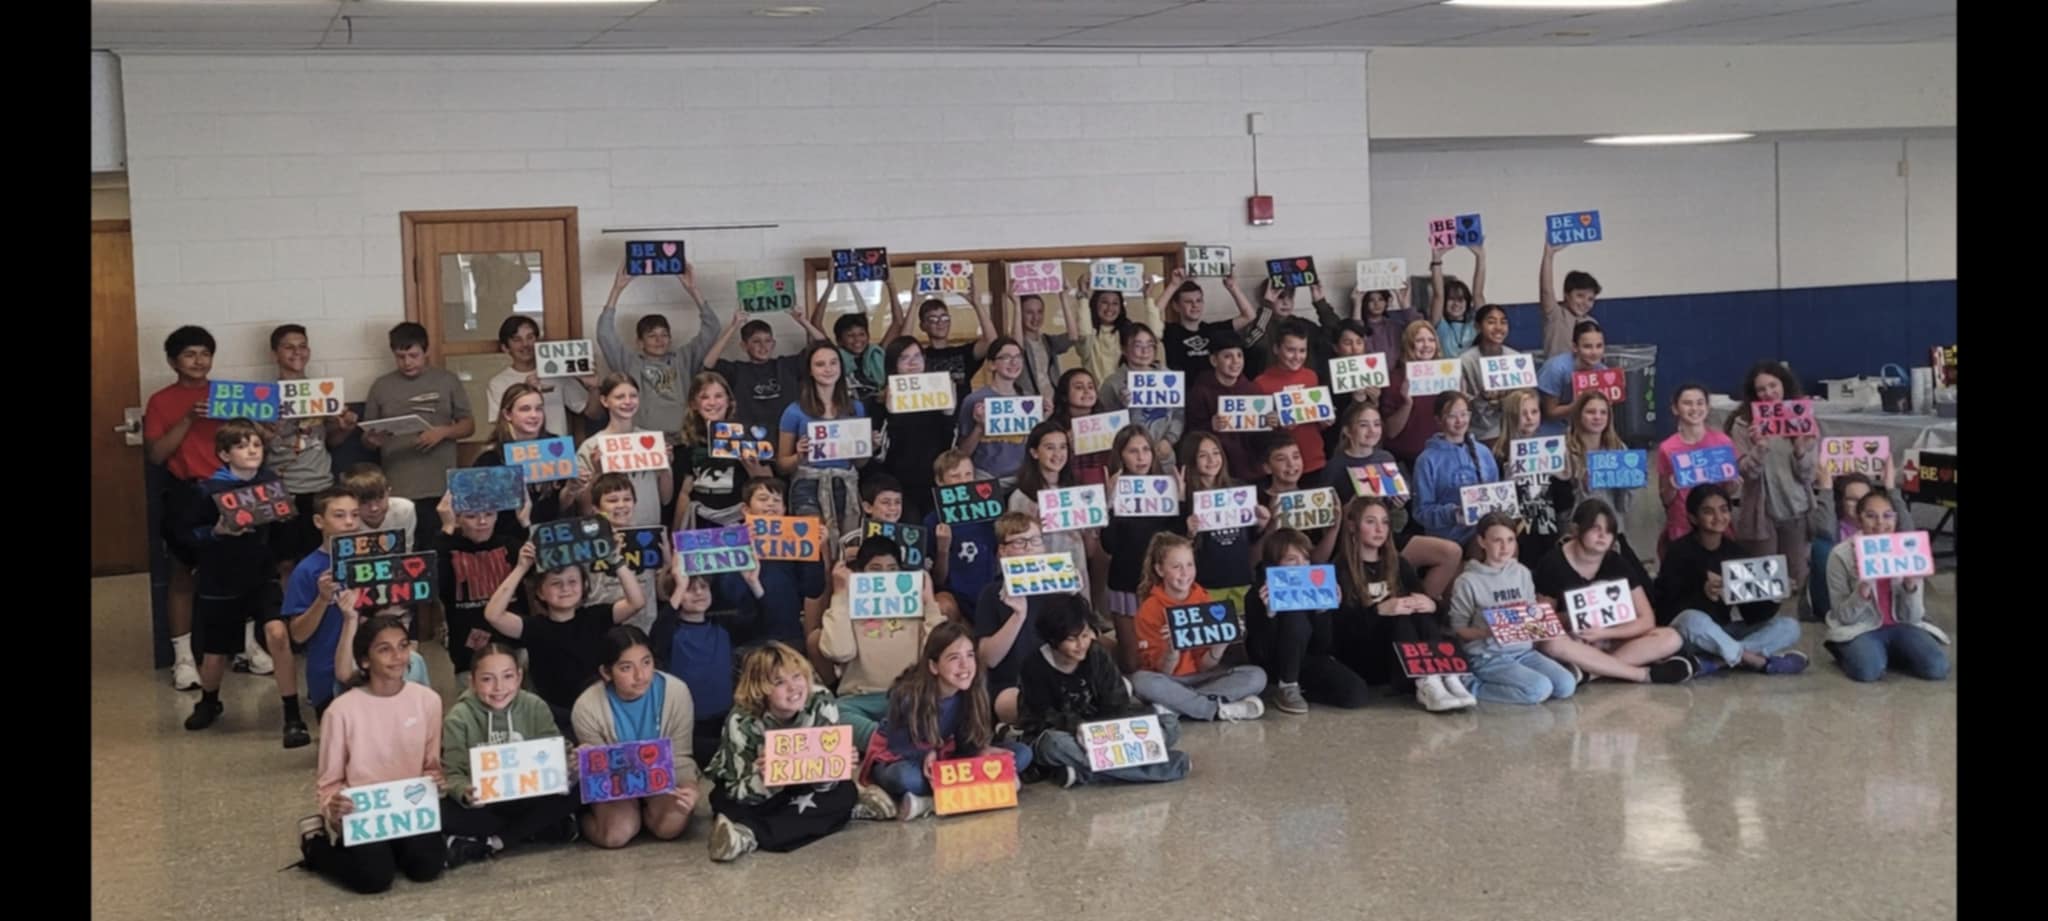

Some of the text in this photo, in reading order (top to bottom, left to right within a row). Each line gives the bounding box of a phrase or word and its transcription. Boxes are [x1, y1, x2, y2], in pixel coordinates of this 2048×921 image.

[1434, 219, 1456, 232] BE
[1552, 216, 1574, 229] BE
[1433, 229, 1479, 246] KIND
[1551, 228, 1597, 244] KIND
[632, 243, 656, 257] BE
[1190, 248, 1209, 260] BE
[632, 259, 682, 274] KIND
[836, 265, 884, 281] KIND
[921, 263, 944, 275] BE
[1014, 264, 1038, 278] BE
[1096, 264, 1117, 275] BE
[920, 277, 970, 291] KIND
[1094, 276, 1140, 289] KIND
[1271, 271, 1314, 288] KIND
[744, 294, 792, 312] KIND
[538, 342, 589, 358] KIND
[565, 359, 589, 371] BE
[1336, 360, 1359, 374] BE
[1412, 363, 1434, 376] BE
[1488, 359, 1508, 371] BE
[895, 377, 921, 392] BE
[1134, 374, 1157, 388] BE
[1337, 372, 1385, 389] KIND
[1411, 379, 1457, 392] KIND
[1489, 372, 1533, 388] KIND
[1578, 373, 1599, 388] BE
[216, 384, 245, 399] BE
[284, 383, 311, 398] BE
[1133, 391, 1181, 405] KIND
[281, 400, 339, 415] KIND
[895, 391, 950, 410] KIND
[990, 401, 1013, 414] BE
[1224, 399, 1245, 412] BE
[1280, 393, 1304, 407] BE
[212, 401, 274, 418] KIND
[1280, 404, 1330, 425] KIND
[1760, 403, 1784, 417] BE
[714, 422, 744, 438] BE
[815, 424, 839, 439] BE
[990, 417, 1039, 432] KIND
[1077, 420, 1100, 434] BE
[1761, 419, 1811, 435] KIND
[606, 438, 632, 451] BE
[711, 440, 775, 459] KIND
[1078, 435, 1114, 452] KIN
[1517, 442, 1539, 456] BE
[1827, 442, 1853, 455] BE
[513, 445, 541, 462] BE
[607, 452, 664, 470] KIND
[1591, 454, 1617, 469] BE
[531, 460, 574, 481] IND
[1513, 455, 1562, 472] KIND
[1827, 458, 1884, 472] KIND
[1591, 470, 1644, 488] KIND
[1678, 463, 1735, 485] KIND
[1920, 466, 1938, 480] BE
[221, 483, 288, 509] KIND
[941, 485, 969, 504] BE
[1120, 480, 1145, 495] BE
[1045, 491, 1072, 507] BE
[1120, 498, 1174, 513] KIND
[1200, 492, 1225, 509] BE
[1280, 495, 1305, 510] BE
[262, 500, 290, 518] BE
[943, 501, 1002, 523] KIND
[1043, 507, 1103, 530] KIND
[1200, 510, 1252, 528] KIND
[1281, 508, 1330, 528] KIND
[540, 523, 574, 543] BE
[754, 520, 782, 535] BE
[337, 536, 370, 554] BE
[681, 532, 710, 548] BE
[755, 540, 813, 557] KIND
[1863, 538, 1892, 555] BE
[539, 538, 610, 571] KIND
[684, 551, 749, 572] KIND
[354, 559, 392, 582] BE
[1009, 557, 1041, 577] BE
[1863, 555, 1927, 576] KIND
[856, 576, 886, 594] BE
[1272, 570, 1304, 587] BE
[354, 581, 430, 609] KIND
[1272, 588, 1335, 609] KIND
[1573, 590, 1600, 609] BE
[854, 596, 919, 616] KIND
[1172, 607, 1203, 625] BE
[1576, 602, 1630, 630] KIND
[1174, 622, 1236, 647] KIND
[1402, 643, 1432, 658] BE
[1407, 656, 1467, 674] KIND
[1091, 724, 1124, 745] BE
[775, 733, 809, 755] BE
[480, 748, 519, 771] BE
[588, 749, 623, 772] BE
[1092, 740, 1162, 769] KIND
[771, 755, 846, 781] KIND
[941, 762, 975, 785] BE
[480, 768, 559, 799] KIND
[586, 767, 667, 797] KIND
[351, 789, 392, 814] BE
[350, 806, 436, 841] KIND
